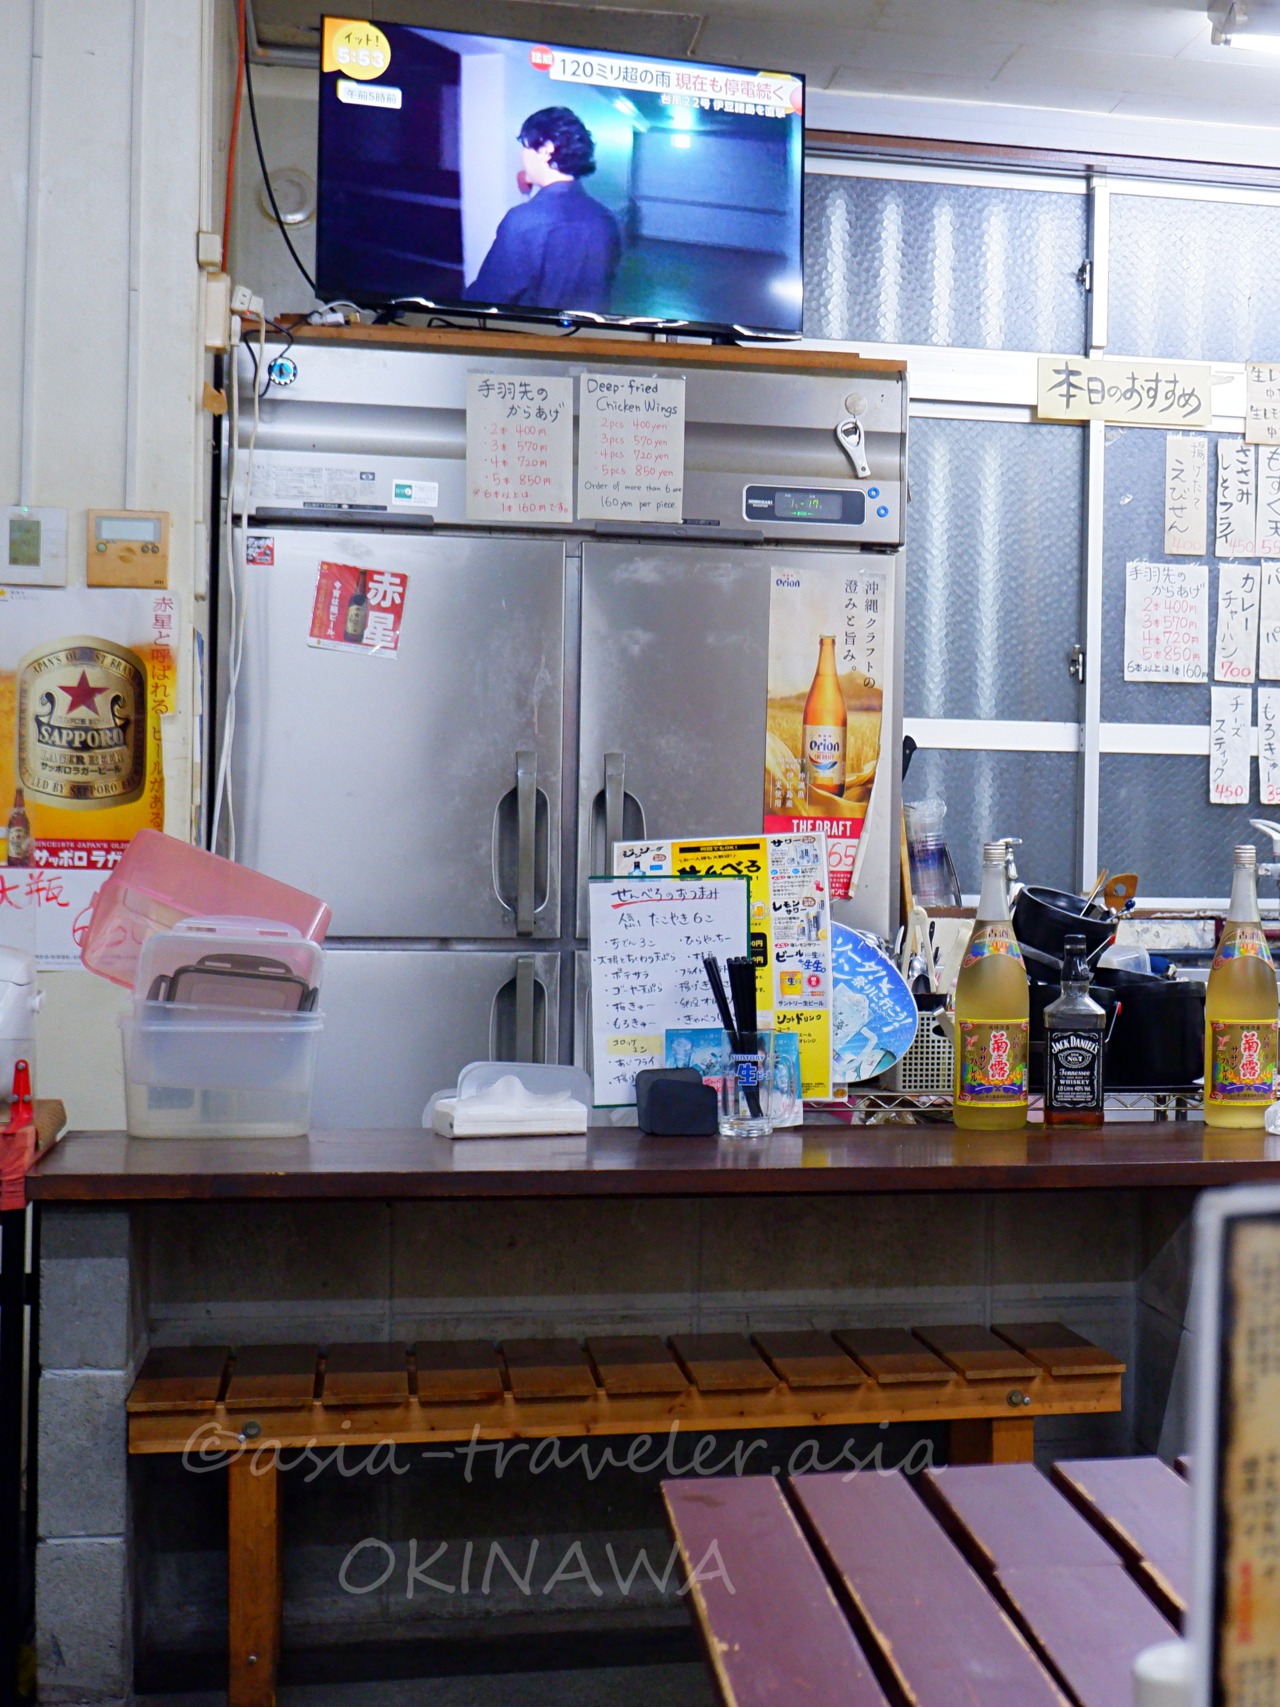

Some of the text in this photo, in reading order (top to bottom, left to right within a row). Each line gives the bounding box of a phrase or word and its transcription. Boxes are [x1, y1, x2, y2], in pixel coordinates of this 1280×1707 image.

[337, 45, 385, 69] 5:53
[560, 58, 785, 101] 120ミリ超の雨 現在も停電続く
[477, 378, 549, 401] 手羽先の
[1046, 361, 1202, 420] 本日のおすすめ
[505, 402, 565, 423] からあげ
[596, 396, 678, 418] Chicken Wings
[601, 418, 625, 430] 2pcs
[601, 433, 625, 446] 3pcs
[600, 449, 625, 460] 4pcs
[601, 464, 626, 476] 5pcs
[584, 481, 608, 490] Order
[1168, 459, 1190, 533] えびせん
[638, 501, 652, 510] per
[775, 577, 800, 588] Orion
[1128, 566, 1187, 583] 手羽先の
[1151, 583, 1206, 600] からあげ
[362, 572, 404, 649] 赤星
[863, 580, 879, 689] 沖縄クラフトの
[150, 596, 174, 715] 赤星と呼ばれる
[1220, 660, 1251, 678] 700
[39, 727, 124, 748] SAPPORO
[809, 738, 840, 752] Orion
[40, 751, 86, 765] LAGER
[40, 762, 123, 777] サッポロラガービール
[1214, 784, 1244, 798] 450
[791, 819, 853, 837] THE DRAFT
[770, 838, 801, 848] サワー
[34, 849, 88, 868] サッポロ
[611, 886, 720, 903] せんべろのおつまみ
[772, 900, 800, 912] レモン
[775, 950, 804, 963] ビール
[611, 968, 650, 980] ポテサラ
[776, 1013, 822, 1025] ソフトドリンク
[1051, 1035, 1100, 1054] JACK DANIEL'S
[730, 1054, 765, 1062] SUNTORY
[988, 1030, 1010, 1081] 菊之露
[1240, 1030, 1261, 1081] 菊之露
[737, 1062, 758, 1086] 生
[1058, 1068, 1091, 1077] Tennessee
